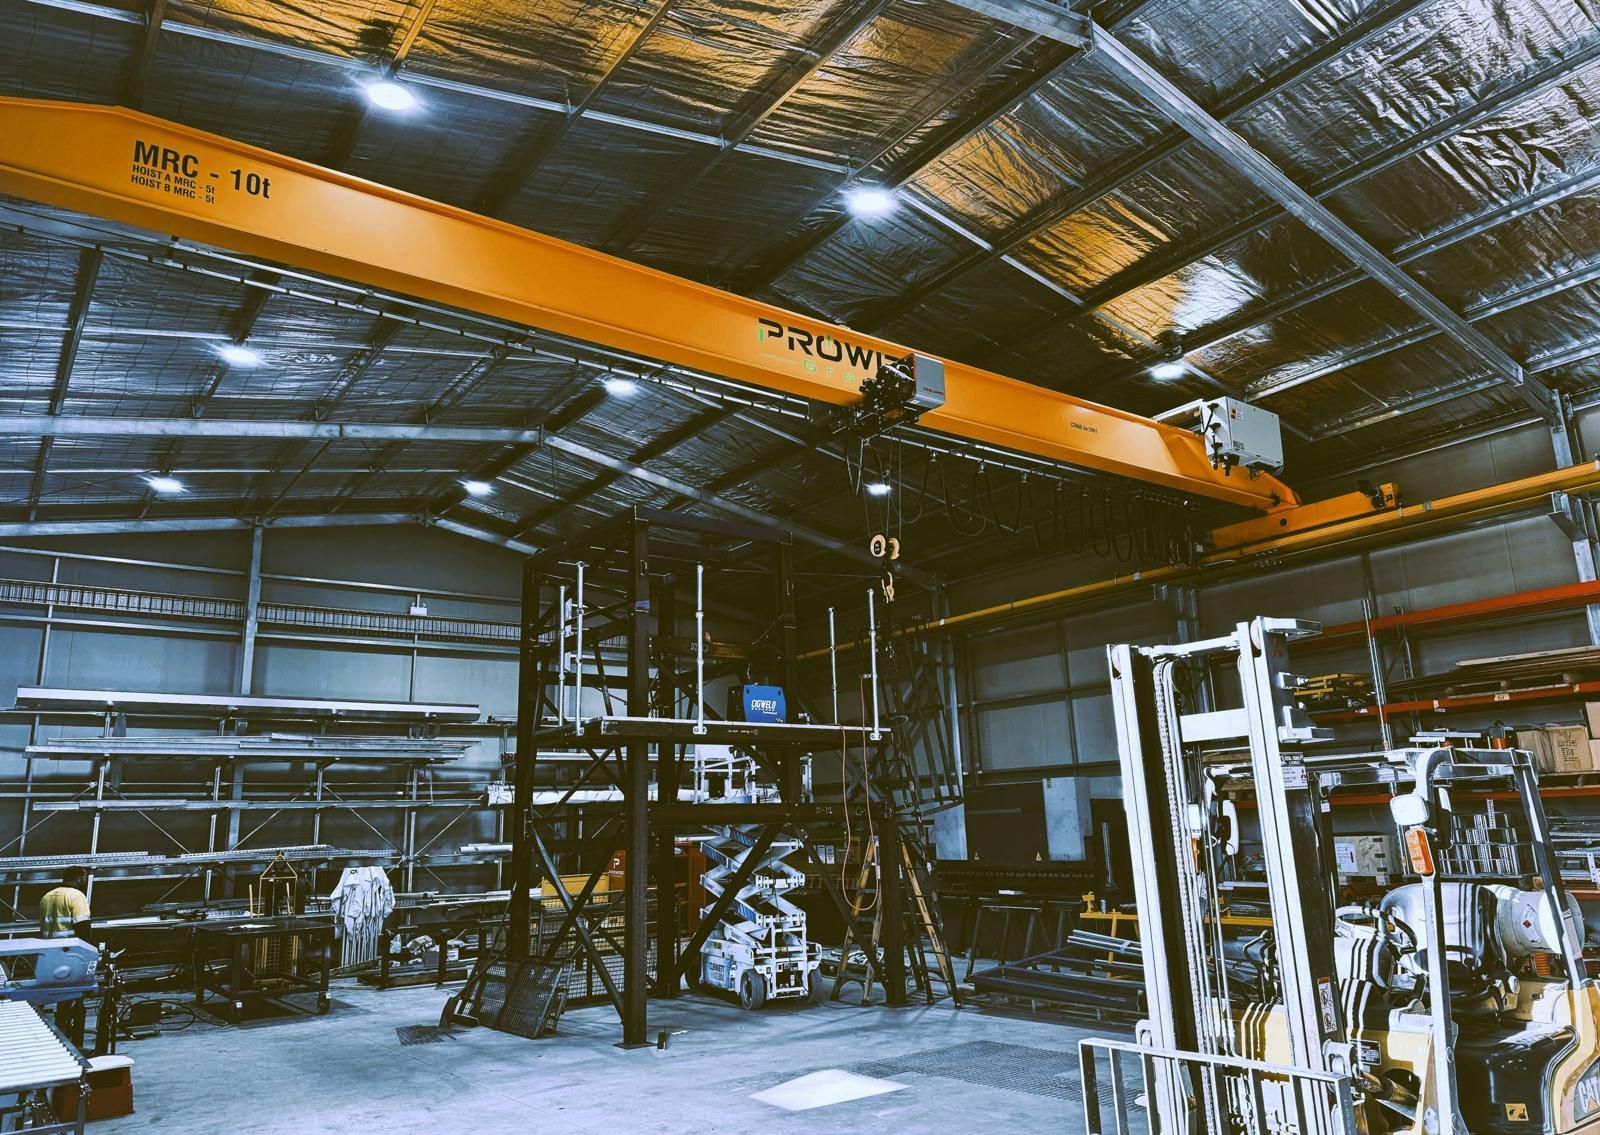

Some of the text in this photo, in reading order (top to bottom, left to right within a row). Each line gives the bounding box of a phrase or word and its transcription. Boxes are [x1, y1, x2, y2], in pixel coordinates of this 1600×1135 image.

[132, 164, 161, 181] HOIST
[164, 173, 172, 182] A
[174, 176, 197, 189] MRC
[205, 184, 215, 195] 5t
[133, 140, 199, 178] MRC
[230, 169, 271, 199] 10t
[131, 174, 161, 190] HOIST
[164, 184, 171, 192] B
[173, 185, 196, 199] MRC
[205, 194, 215, 204] 5t
[803, 359, 857, 384] Gro
